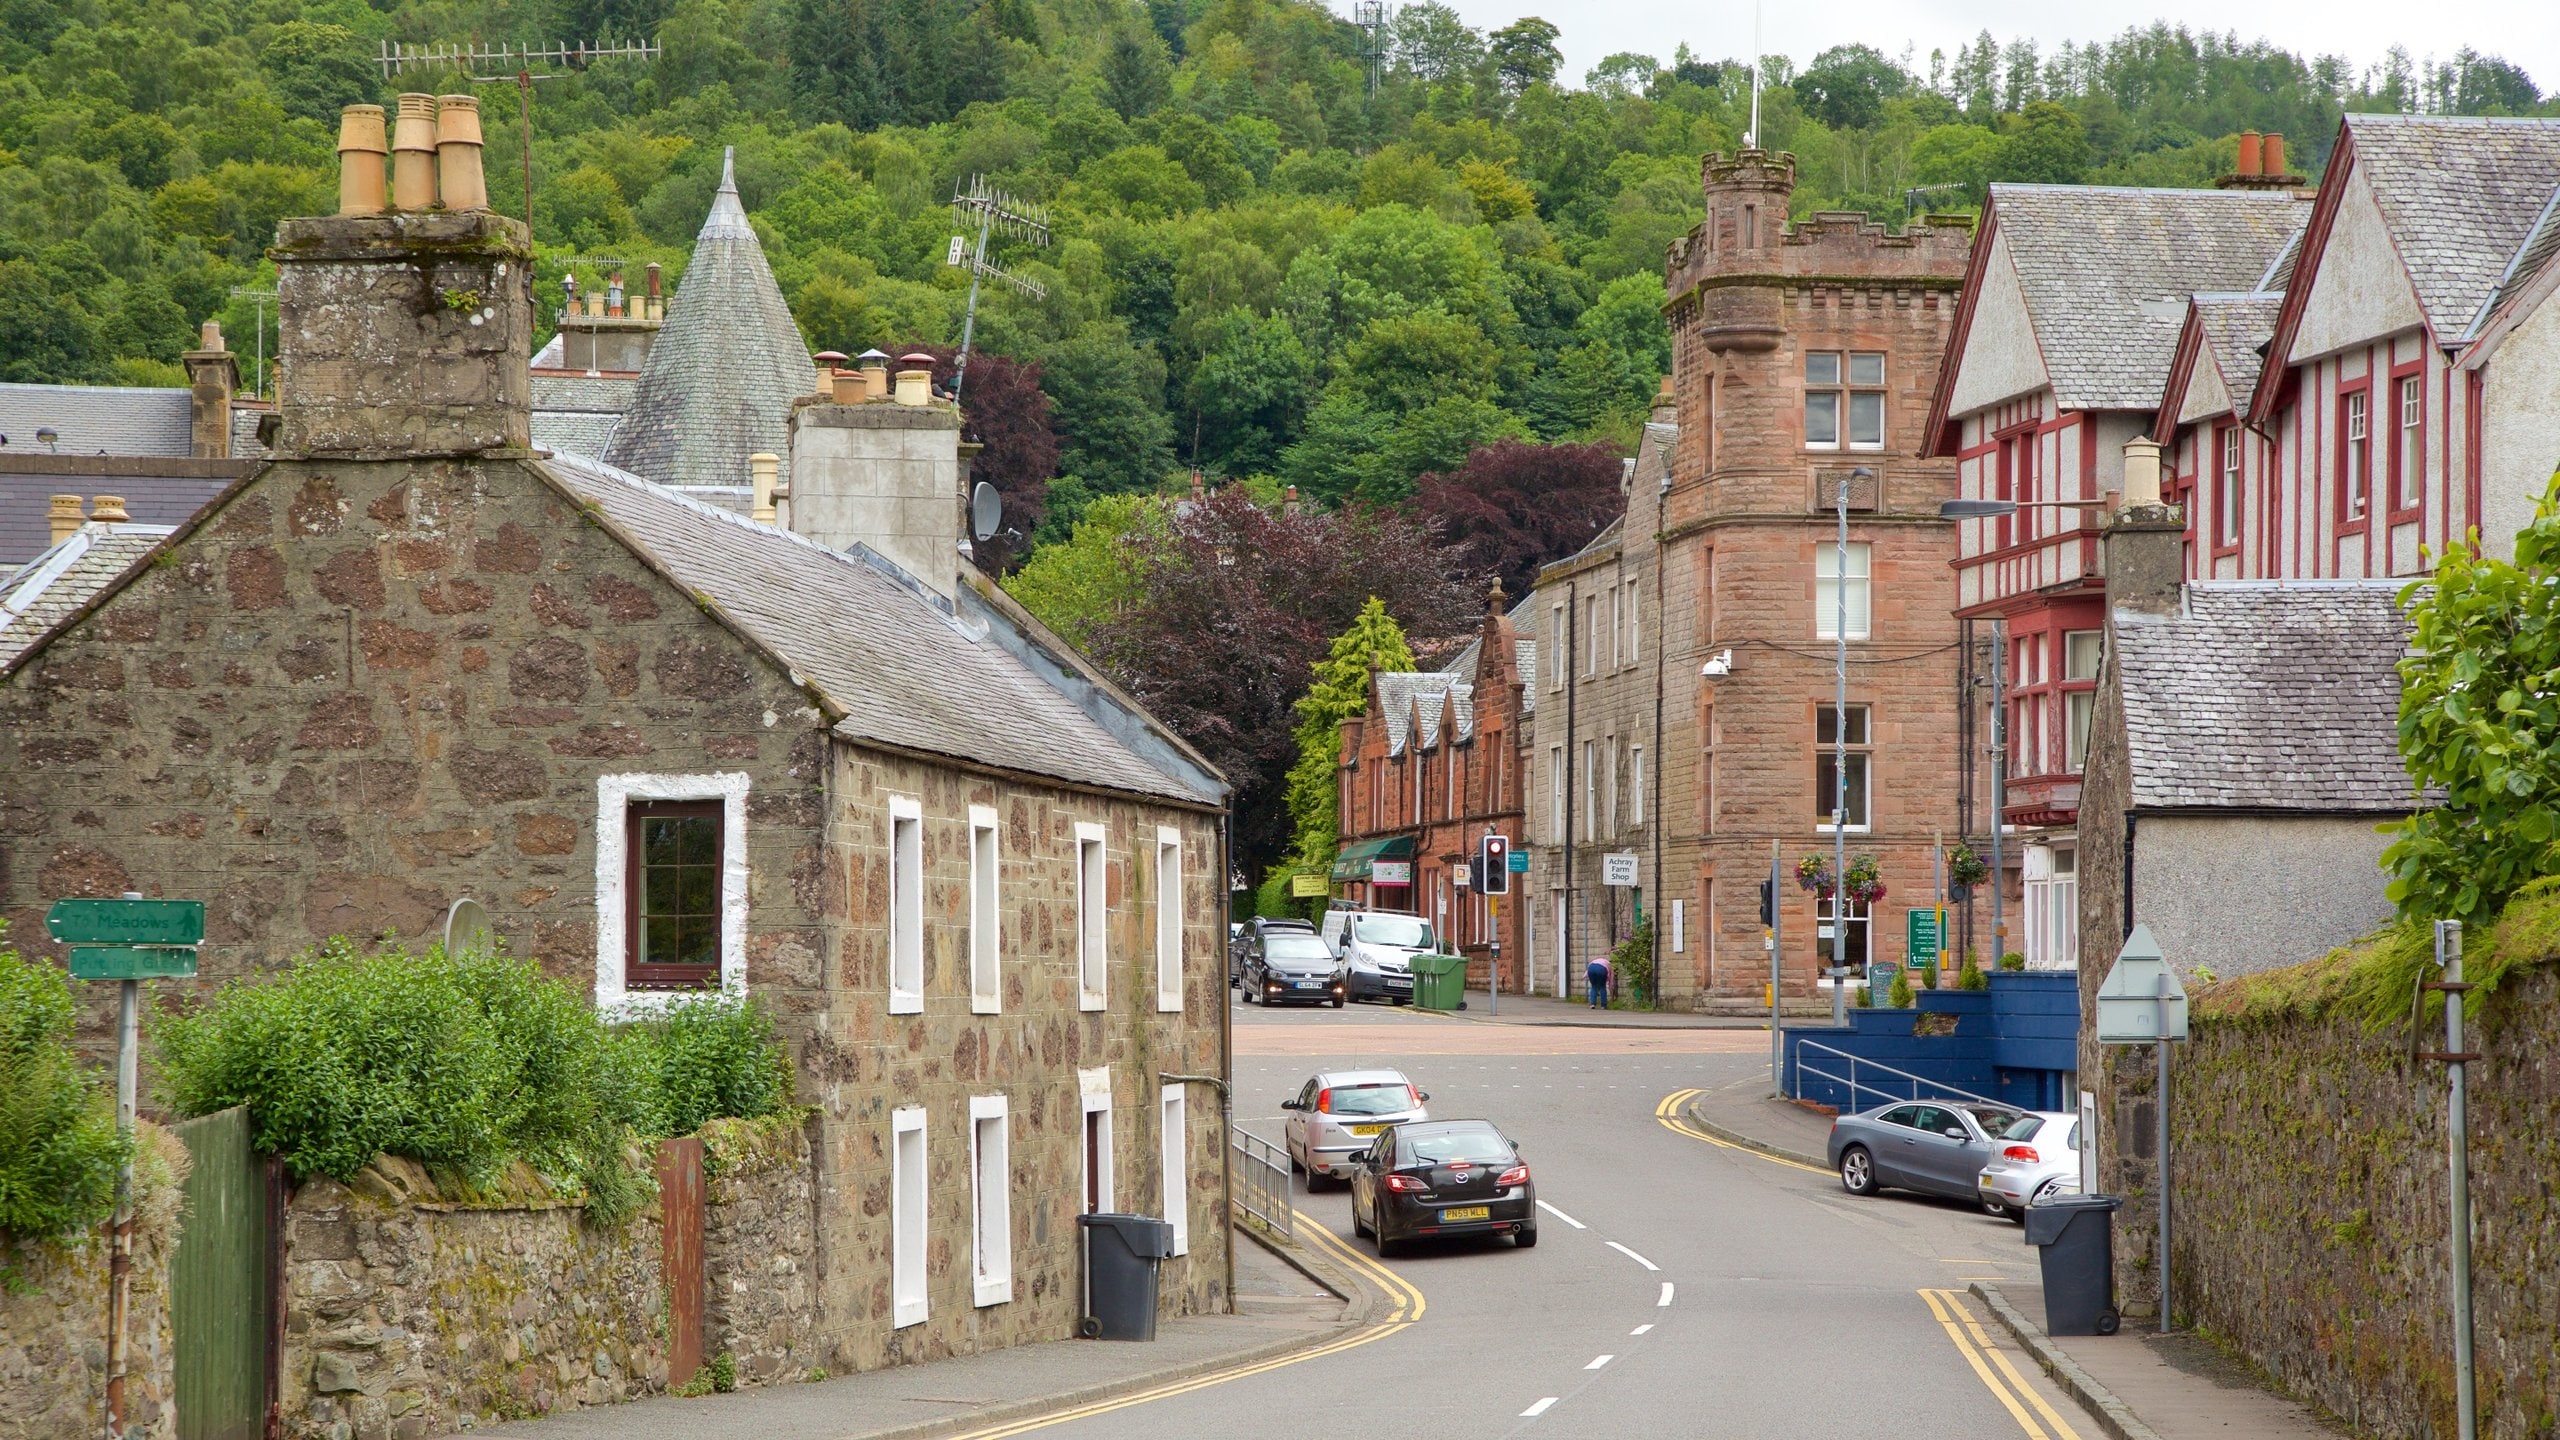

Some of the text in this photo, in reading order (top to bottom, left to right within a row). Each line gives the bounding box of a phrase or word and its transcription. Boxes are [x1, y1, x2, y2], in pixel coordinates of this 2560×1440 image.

[1608, 858, 1633, 867] Achray
[1611, 873, 1629, 881] Shop
[97, 914, 169, 929] Meadows
[78, 956, 187, 971] Puting Gree
[1356, 1126, 1376, 1134] GK04
[1446, 1209, 1469, 1218] PN59
